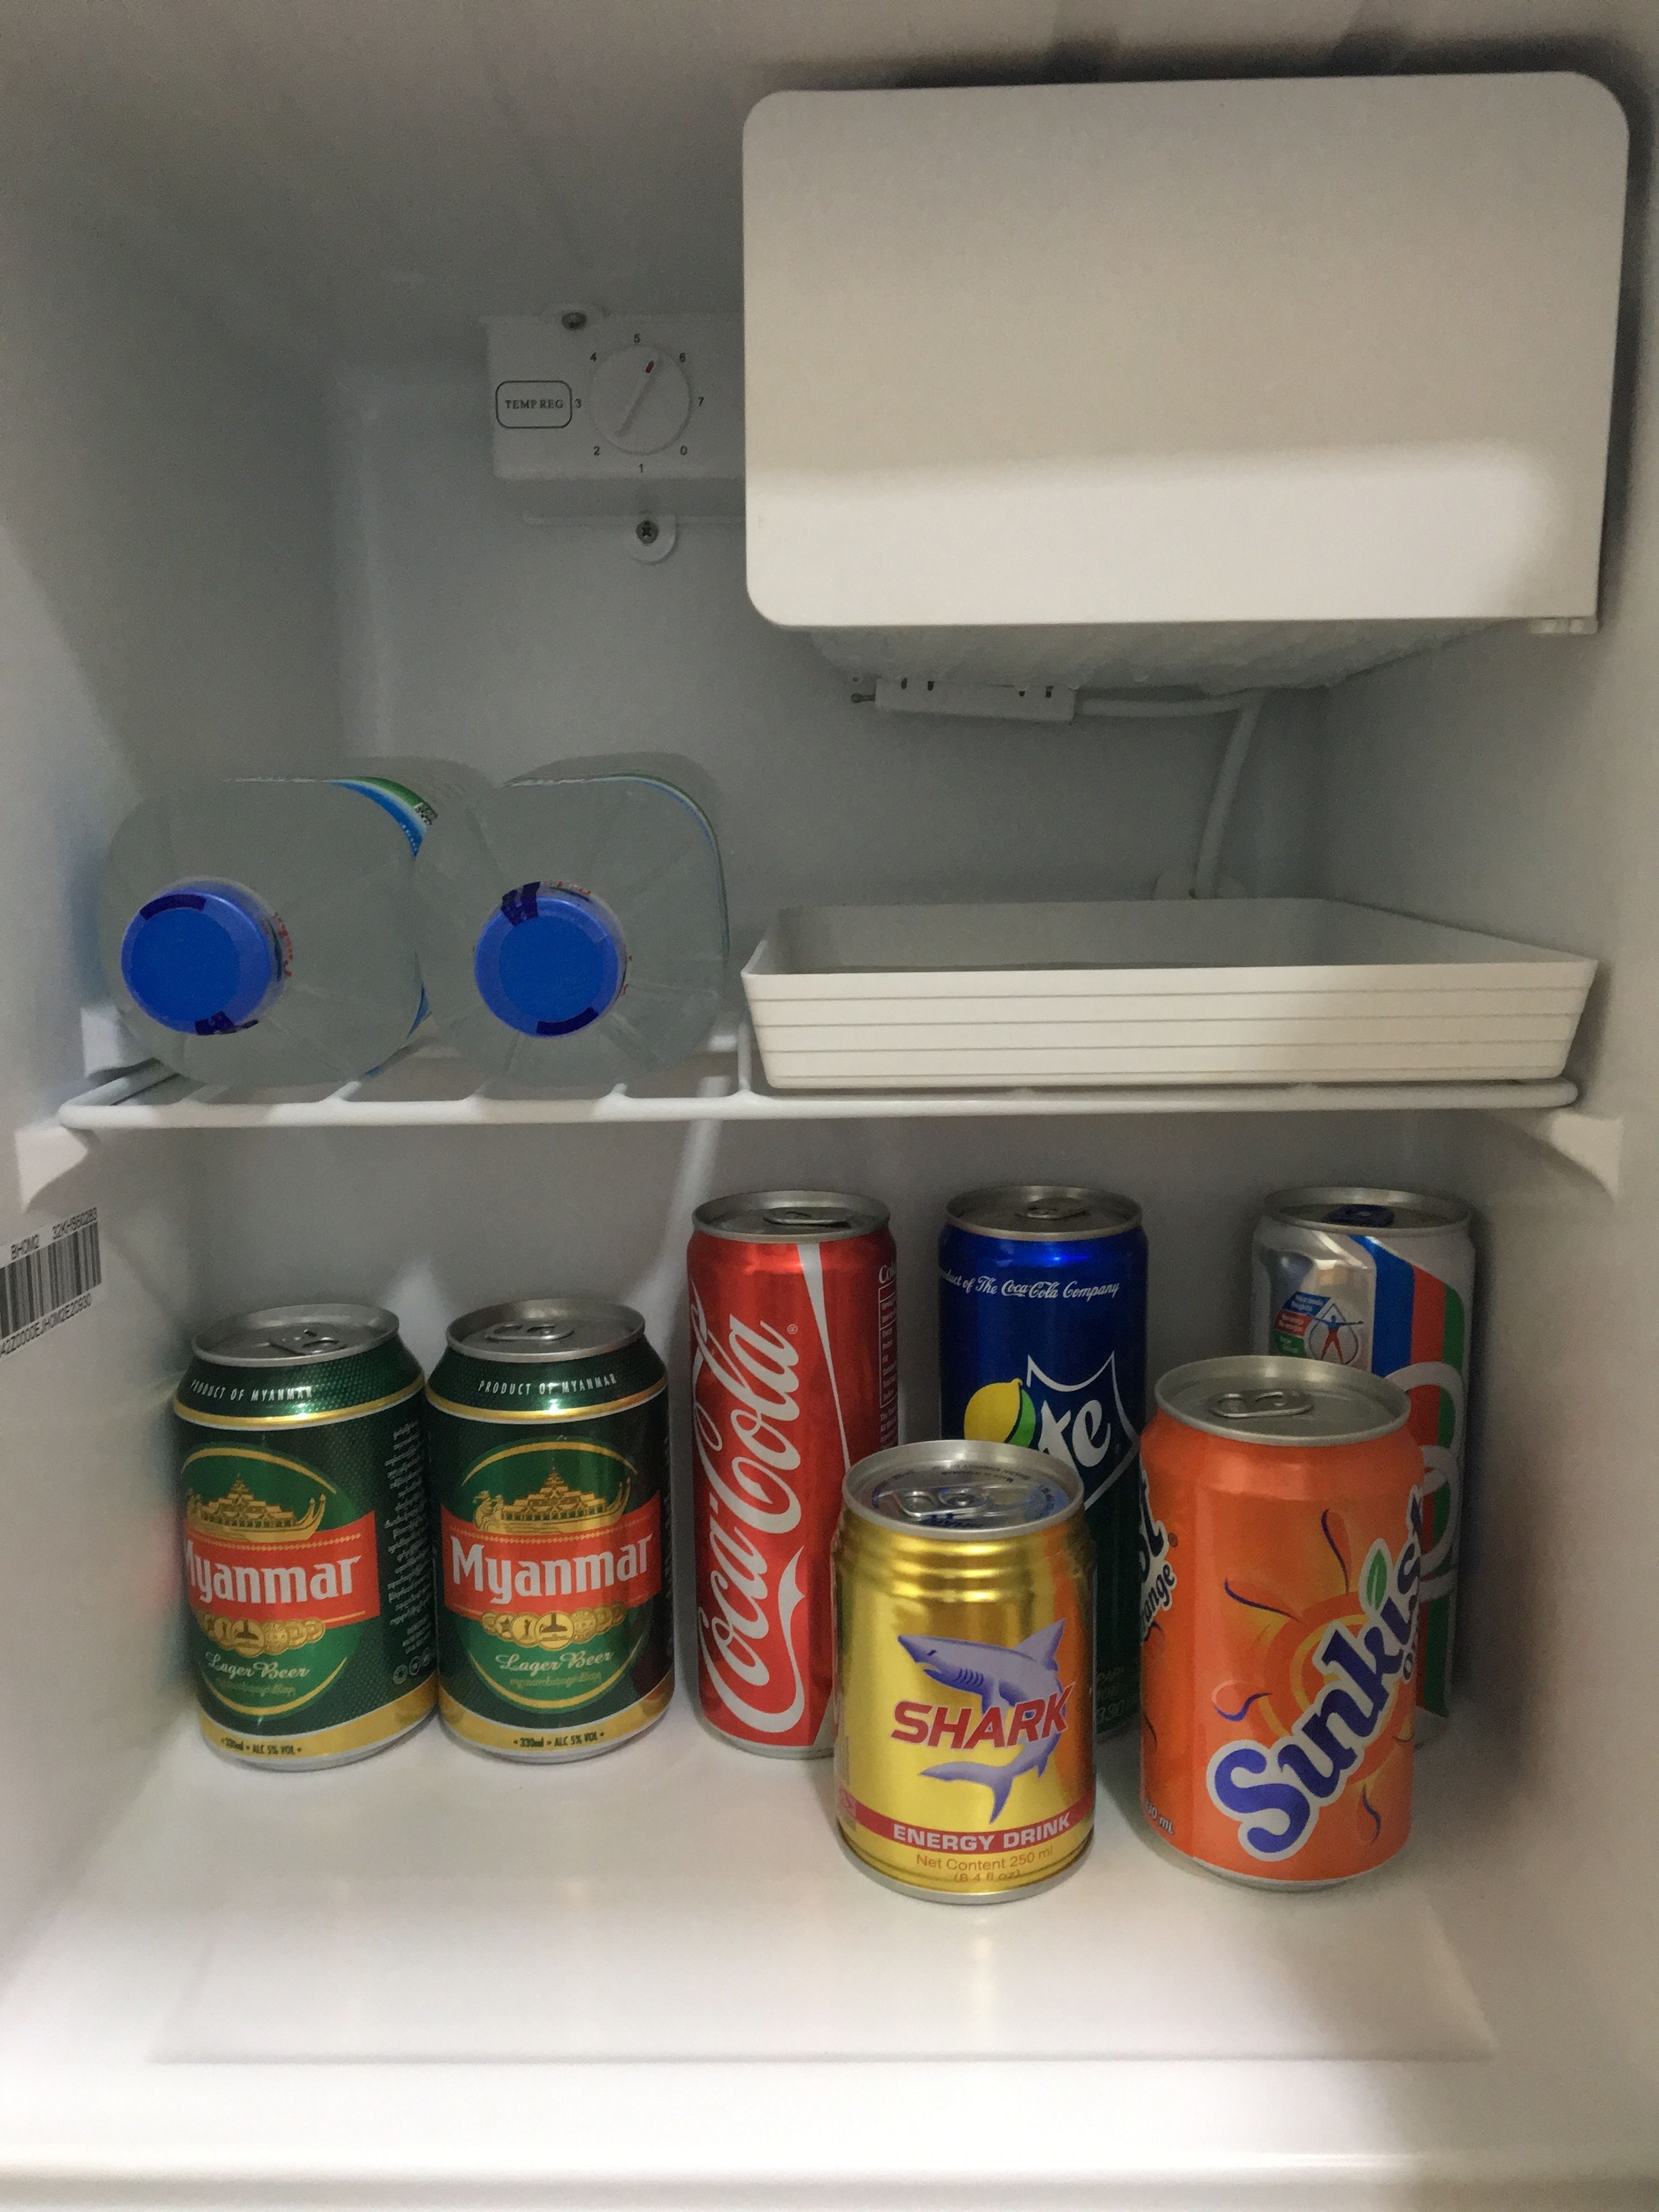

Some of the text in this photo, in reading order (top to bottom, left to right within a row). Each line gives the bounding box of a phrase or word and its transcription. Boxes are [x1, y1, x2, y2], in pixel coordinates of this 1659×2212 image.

[634, 333, 641, 343] 5
[590, 352, 597, 362] 4
[679, 352, 686, 363] 6
[505, 399, 563, 410] TEMP REG
[575, 398, 582, 408] 3
[698, 396, 704, 407] 7
[593, 446, 601, 456] 2
[680, 445, 688, 456] 0
[639, 463, 643, 474] 1
[963, 1278, 976, 1293] of
[975, 1275, 998, 1294] The
[1001, 1279, 1060, 1298] Coca-Cola
[1063, 1280, 1120, 1302] Company
[478, 1373, 618, 1395] PRODUCT OF MYANMAR
[230, 1388, 245, 1401] OF
[250, 1385, 313, 1402] MYANMAR
[691, 1288, 806, 1733] Coca-Cola
[450, 1533, 653, 1604] Myanmar
[205, 1652, 310, 1680] Lager Beer
[495, 1650, 614, 1677] Lager Beer
[891, 1681, 1075, 1749] SHARK
[520, 1732, 598, 1748] 330ml ALC 5% VOL
[893, 1813, 1072, 1851] ENERGY DRINK
[916, 1845, 1053, 1872] Net Content 250 ml
[953, 1872, 981, 1883] (84
